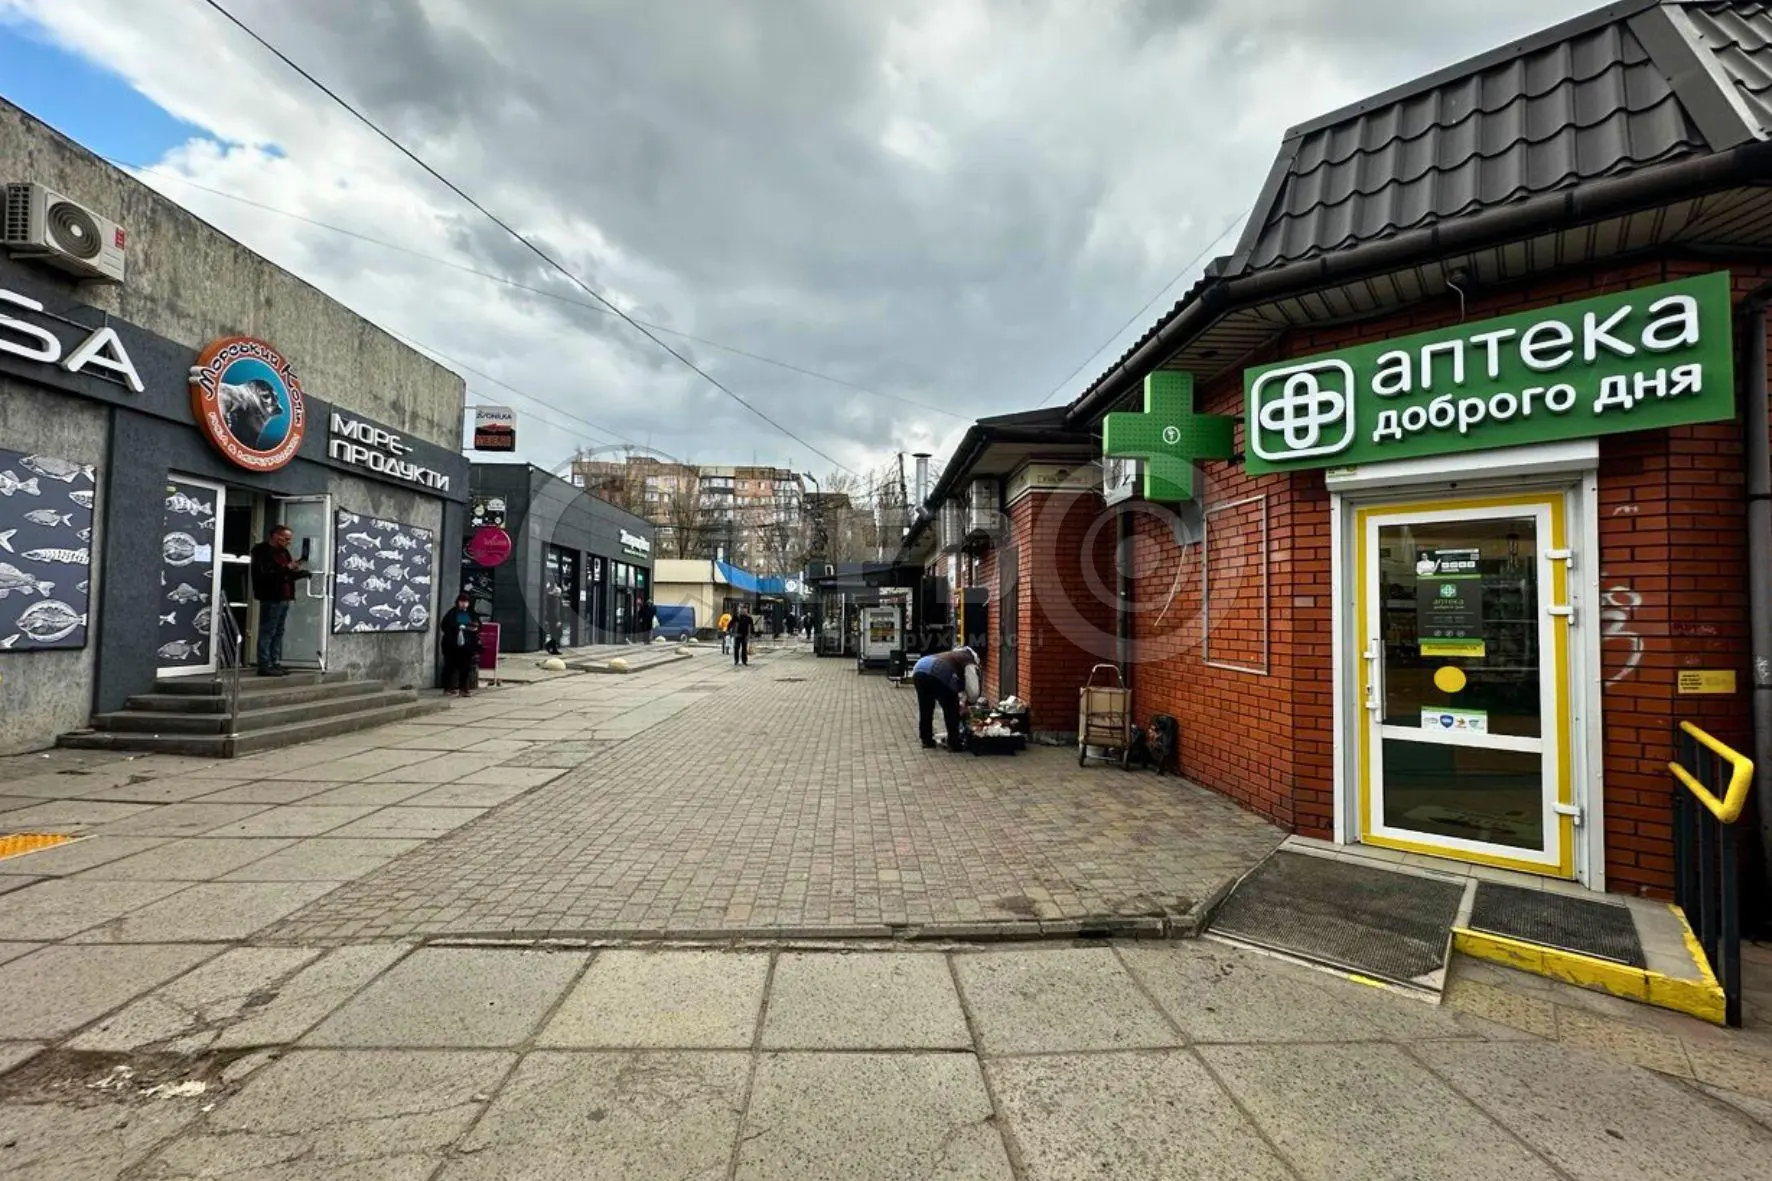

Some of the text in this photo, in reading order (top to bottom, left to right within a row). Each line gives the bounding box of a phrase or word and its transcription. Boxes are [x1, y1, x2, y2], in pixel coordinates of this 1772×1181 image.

[1371, 294, 1700, 396] аптека
[329, 413, 413, 455] МОРЕ-
[1372, 362, 1703, 444] доброго дня
[327, 440, 450, 493] ПРОДУКТИ
